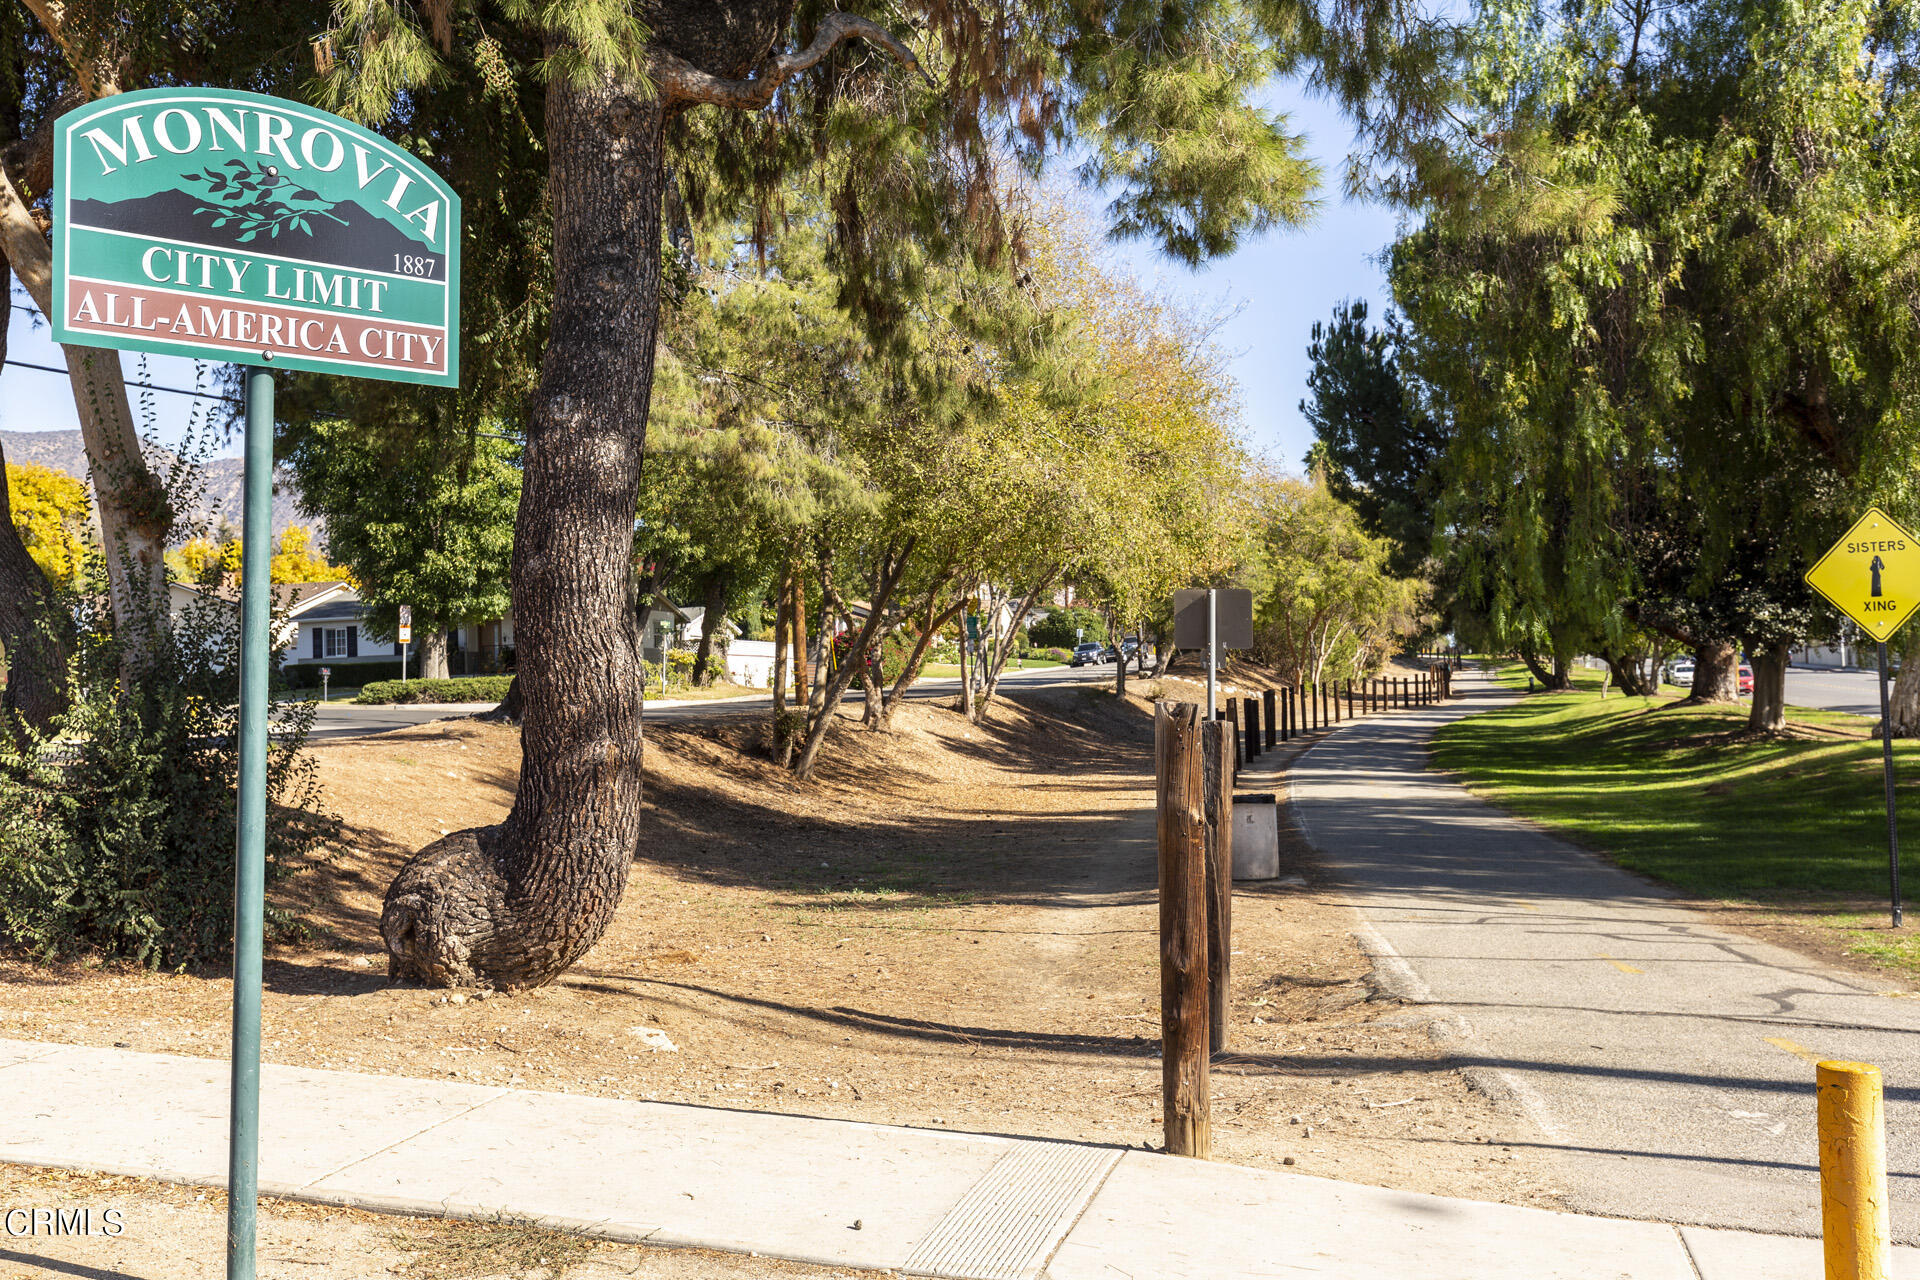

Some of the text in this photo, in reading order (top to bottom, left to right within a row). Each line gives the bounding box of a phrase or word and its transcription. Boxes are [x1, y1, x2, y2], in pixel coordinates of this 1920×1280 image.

[80, 107, 441, 244] MONROVIA
[141, 246, 388, 313] CITY LIMIT
[393, 253, 436, 279] 1887
[73, 290, 443, 366] ALL-AMERICA CITY
[1847, 540, 1906, 553] SISTERS
[1863, 600, 1897, 612] XING
